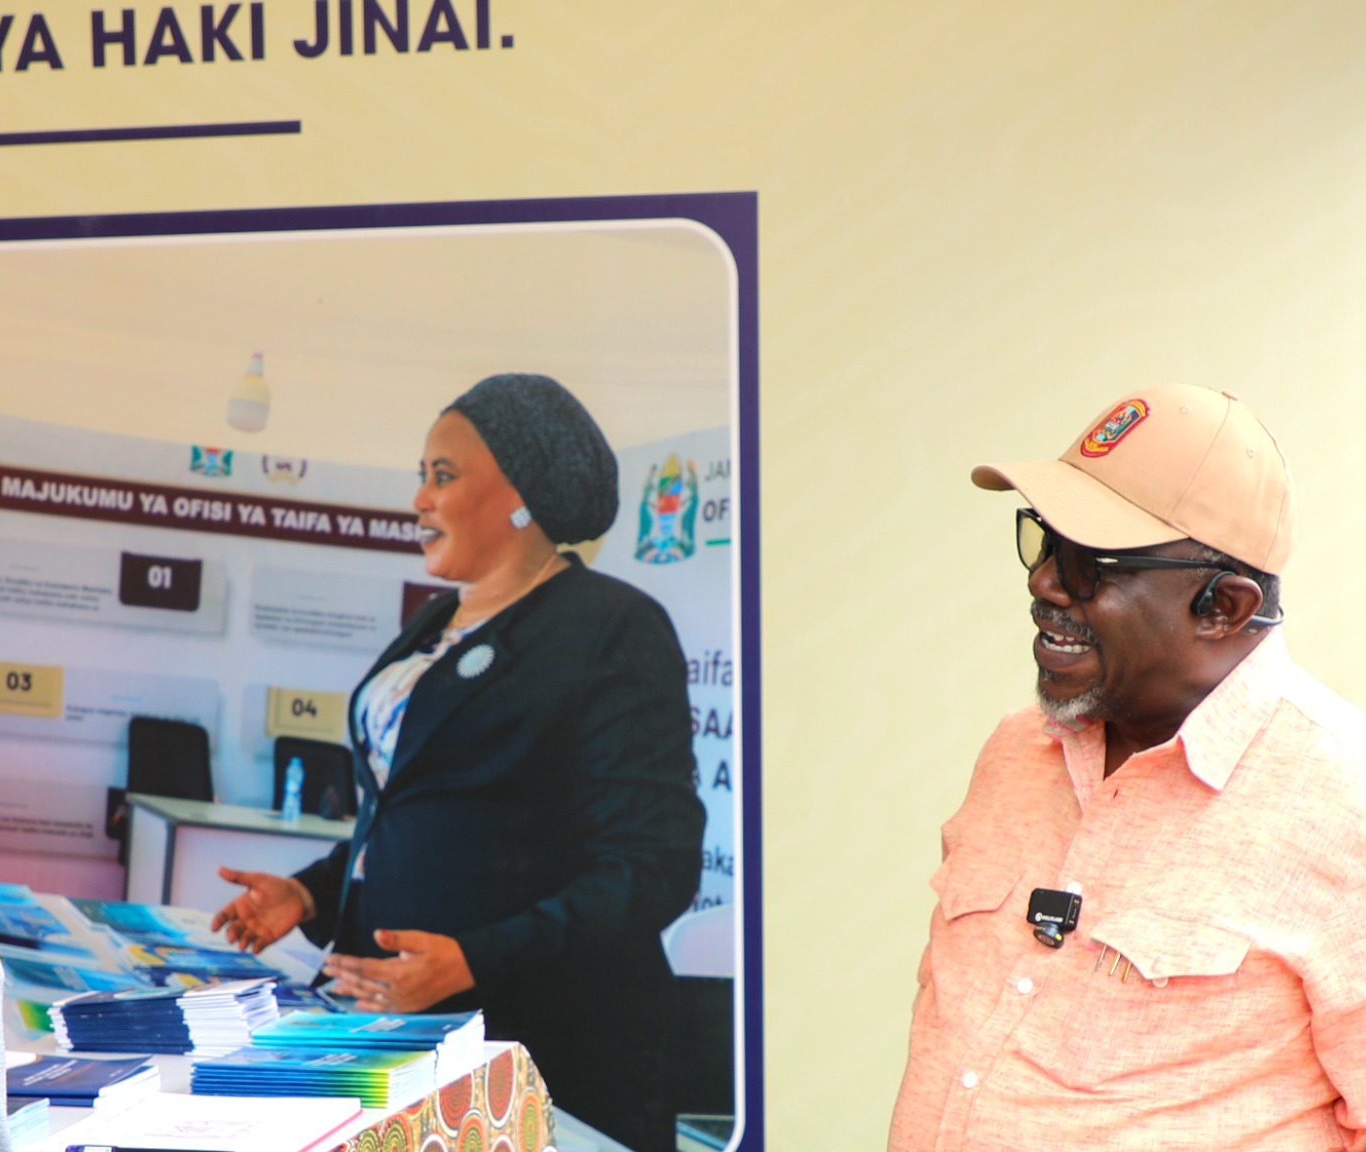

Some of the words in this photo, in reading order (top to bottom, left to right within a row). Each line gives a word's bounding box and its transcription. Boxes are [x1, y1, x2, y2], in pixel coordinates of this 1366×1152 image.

[91, 2, 266, 68] HAKI
[293, 0, 514, 58] JINAI.
[1, 476, 133, 511] MAJUKUMU
[139, 492, 168, 515] YA
[173, 496, 232, 522] OFISI
[237, 503, 266, 526] YA
[271, 507, 332, 534] TAIFA
[337, 514, 365, 537] YA
[147, 564, 172, 590] 01
[6, 670, 33, 692] 03
[687, 650, 732, 686] aifa
[291, 697, 317, 719] 04
